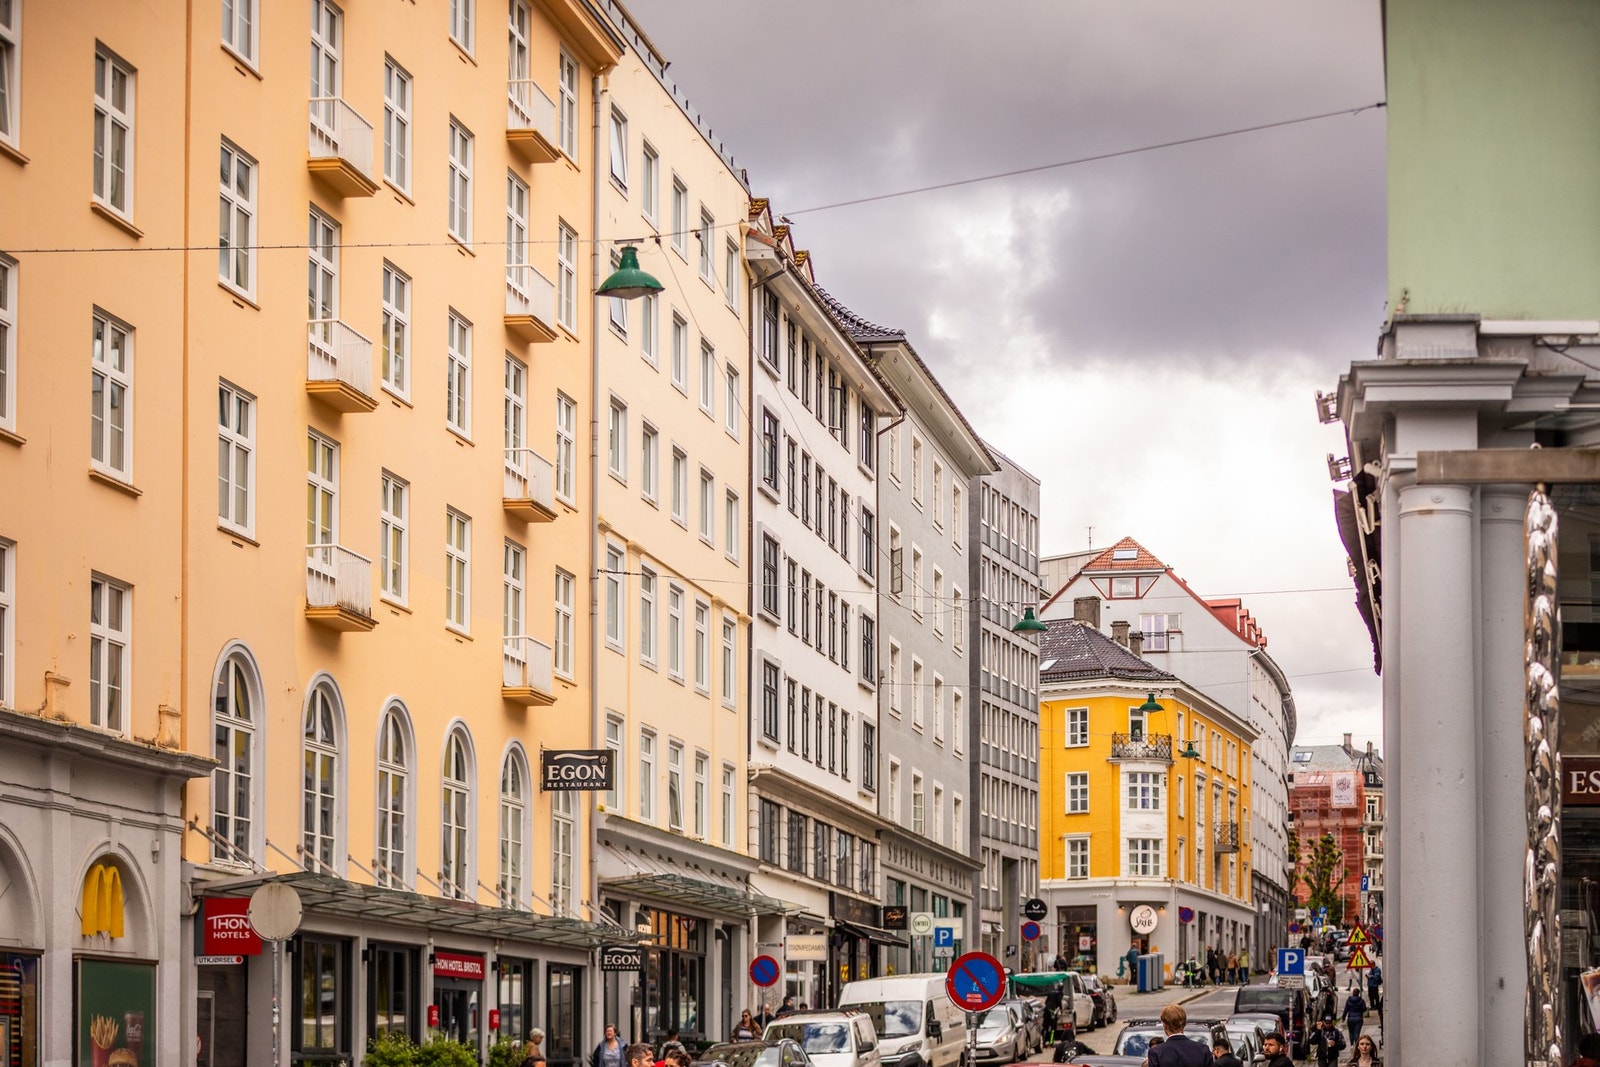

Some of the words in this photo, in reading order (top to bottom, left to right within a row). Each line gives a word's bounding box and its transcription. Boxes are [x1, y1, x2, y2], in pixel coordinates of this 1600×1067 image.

[547, 764, 607, 781] EGON
[207, 914, 251, 930] THON
[213, 931, 250, 939] HOTELS
[939, 930, 950, 945] P
[448, 959, 464, 972] HOTEL
[463, 961, 482, 974] BRISTOL
[603, 954, 641, 965] EGON
[1284, 951, 1299, 972] P
